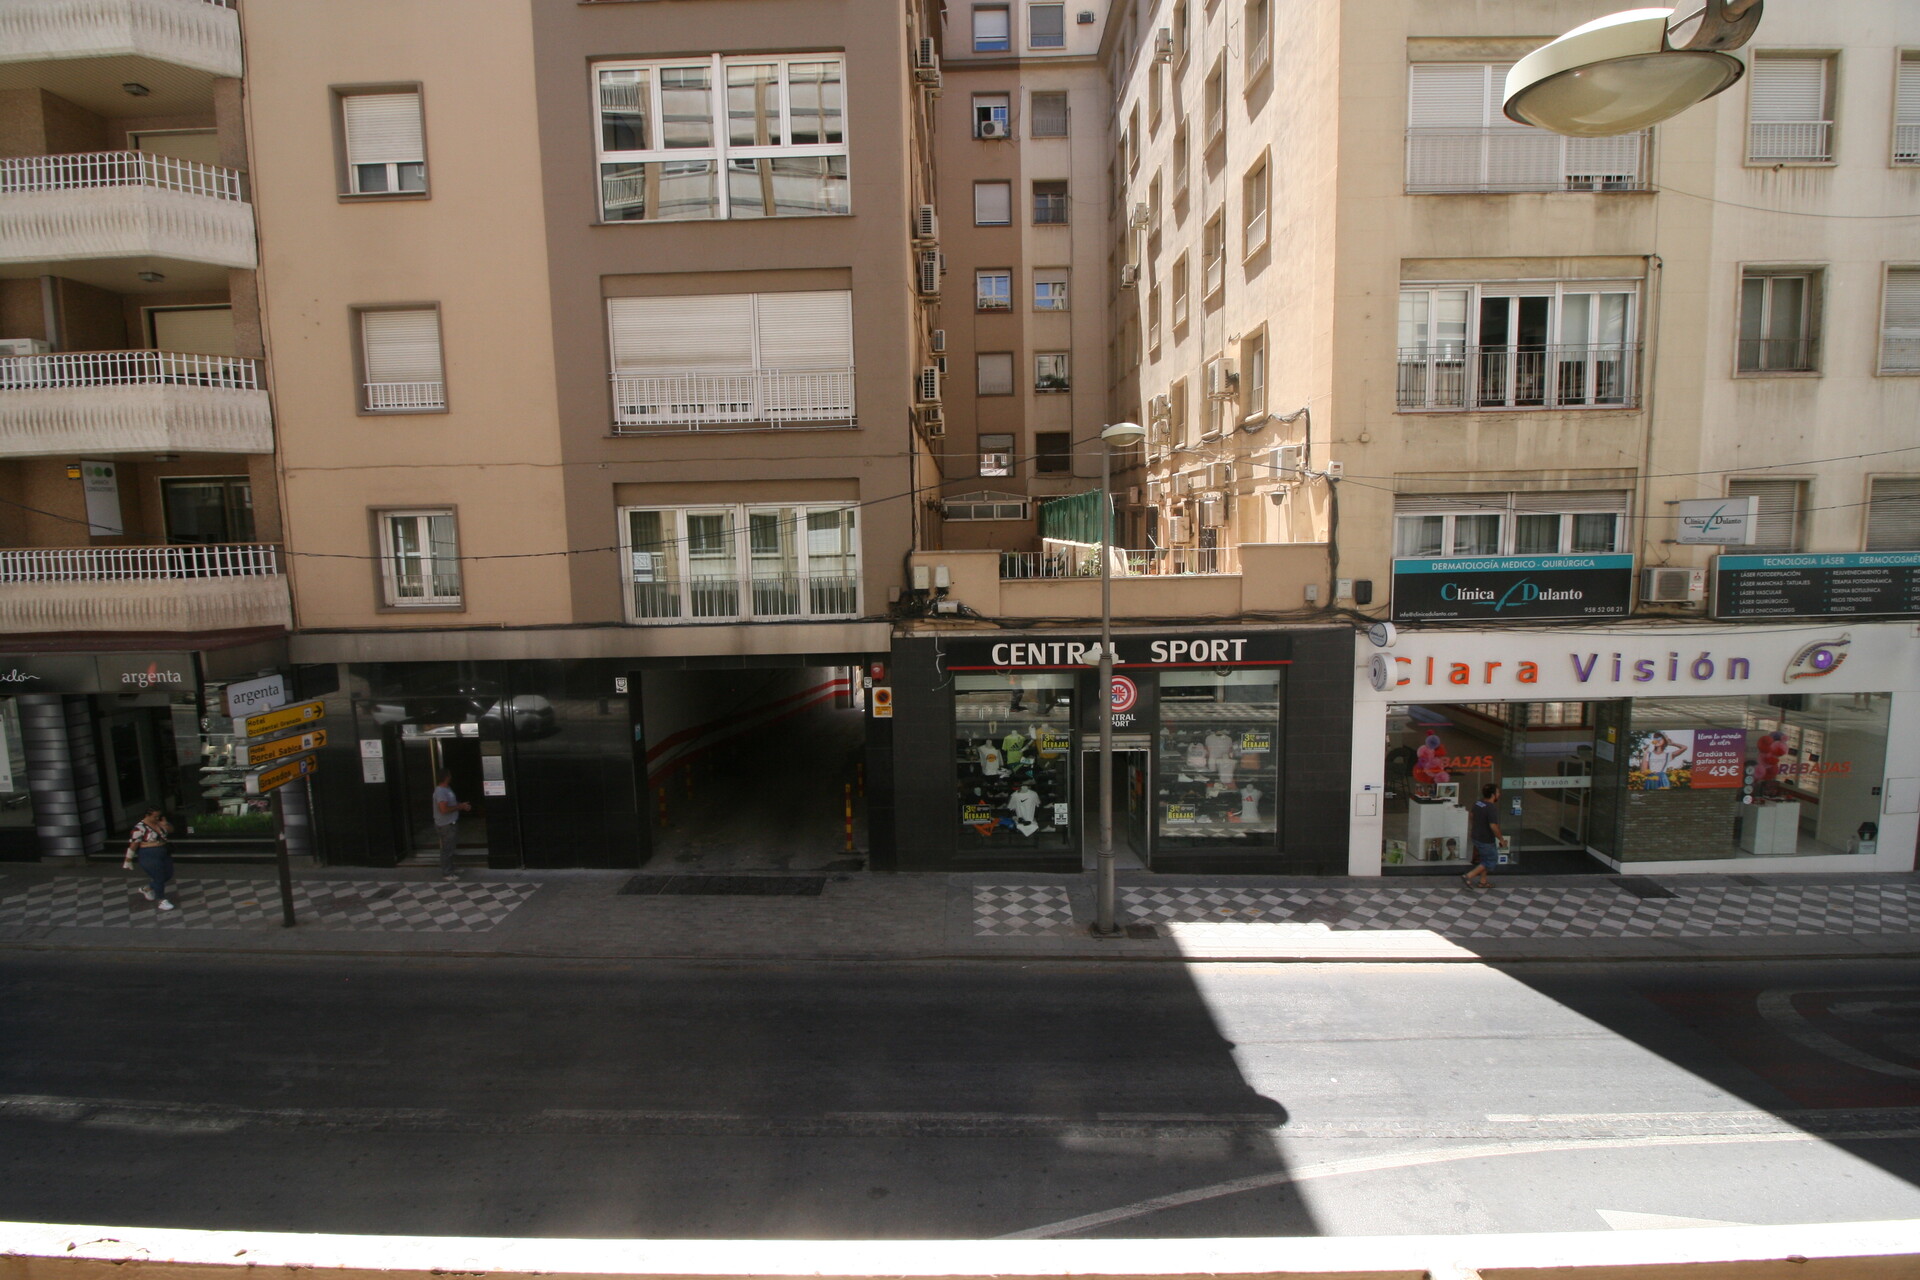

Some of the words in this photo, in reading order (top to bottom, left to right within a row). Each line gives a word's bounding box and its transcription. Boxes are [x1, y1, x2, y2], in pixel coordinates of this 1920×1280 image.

[1432, 560, 1499, 571] DERMATOLOGÍA
[1501, 560, 1536, 569] MEDICO
[1541, 558, 1595, 568] QUIRÚRGICA
[1821, 556, 1845, 565] LÁSER
[1440, 583, 1494, 601] Clínica
[1522, 583, 1583, 601] Dulanto
[1150, 638, 1248, 663] SPORT
[1570, 651, 1750, 683] Visión
[121, 669, 182, 688] argenta
[233, 685, 280, 706] argenta
[247, 717, 266, 727] Hotel
[1709, 765, 1739, 776] 49€
[1778, 761, 1852, 774] REBAJAS
